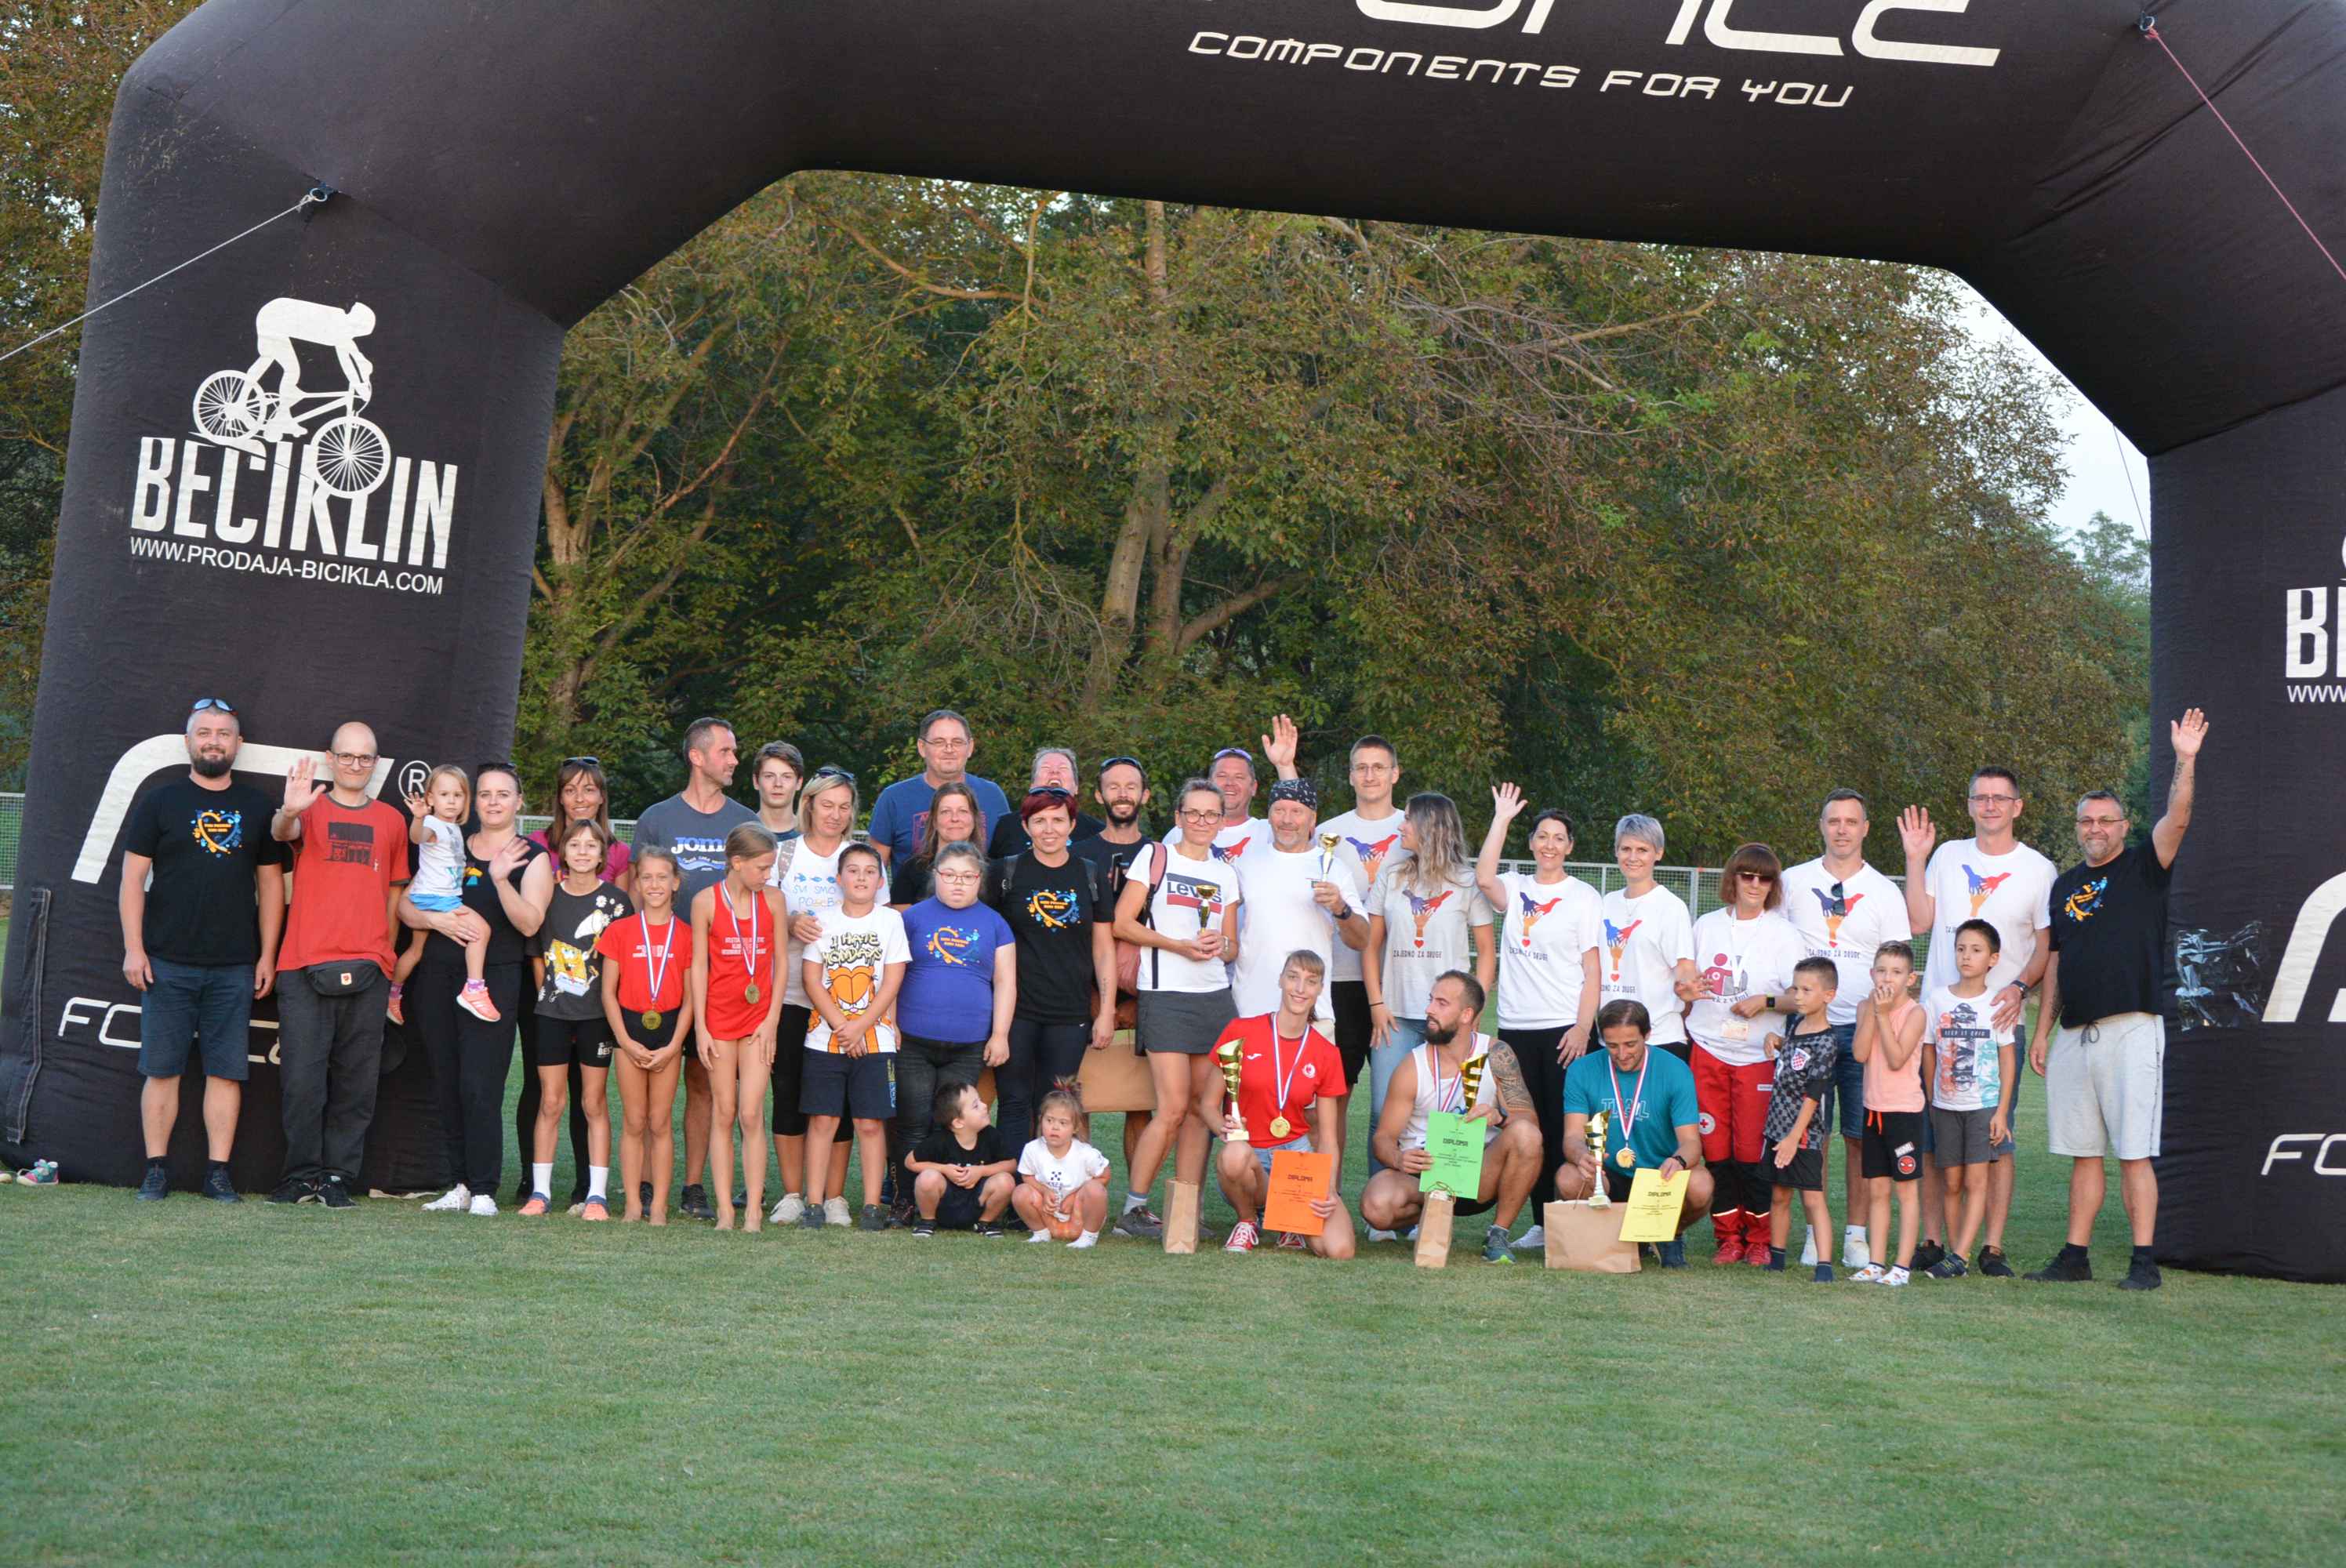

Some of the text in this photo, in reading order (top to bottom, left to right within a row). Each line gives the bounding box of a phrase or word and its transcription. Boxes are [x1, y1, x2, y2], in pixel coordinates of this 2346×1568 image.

[1187, 31, 1581, 88] COMPONENTS
[1600, 70, 1721, 100] FOR
[1741, 78, 1854, 107] YOU
[130, 536, 443, 595] WWW.PRODAJA-BICIKLA.COM
